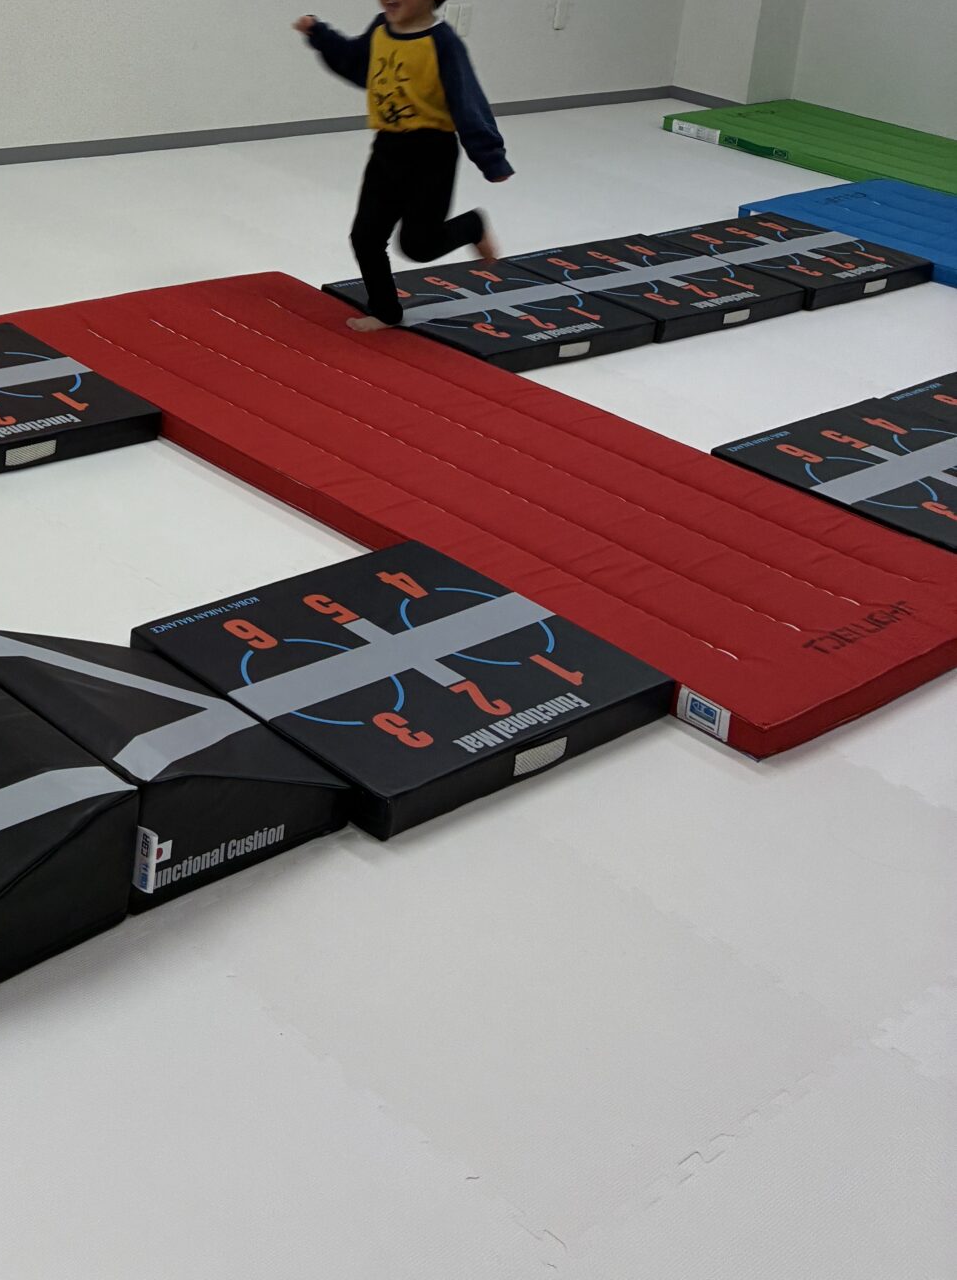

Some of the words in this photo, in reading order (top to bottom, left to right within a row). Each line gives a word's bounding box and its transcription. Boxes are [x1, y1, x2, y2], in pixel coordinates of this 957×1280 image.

[690, 233, 723, 245] 6
[724, 227, 758, 238] 5
[624, 243, 657, 256] 4
[853, 250, 886, 262] 1
[546, 257, 581, 270] 6
[587, 251, 621, 264] 5
[821, 256, 856, 270] 2
[469, 269, 502, 282] 4
[787, 264, 824, 277] 3
[424, 276, 459, 290] 5
[681, 283, 718, 298] 2
[722, 278, 754, 290] 1
[643, 292, 681, 306] 3
[567, 307, 601, 320] 1
[472, 322, 511, 338] 3
[519, 315, 557, 330] 2
[51, 391, 89, 411] 1
[861, 417, 909, 435] 4
[819, 429, 869, 449] 5
[775, 443, 824, 464] 6
[377, 571, 429, 598] 4
[304, 593, 359, 625] 5
[222, 619, 279, 650] 6
[530, 653, 585, 687] 1
[449, 680, 513, 716] 2
[488, 692, 591, 739] Functional
[373, 713, 434, 749] 3
[452, 728, 504, 753] Mat
[154, 843, 226, 890] unctional
[227, 824, 285, 860] Cushion
